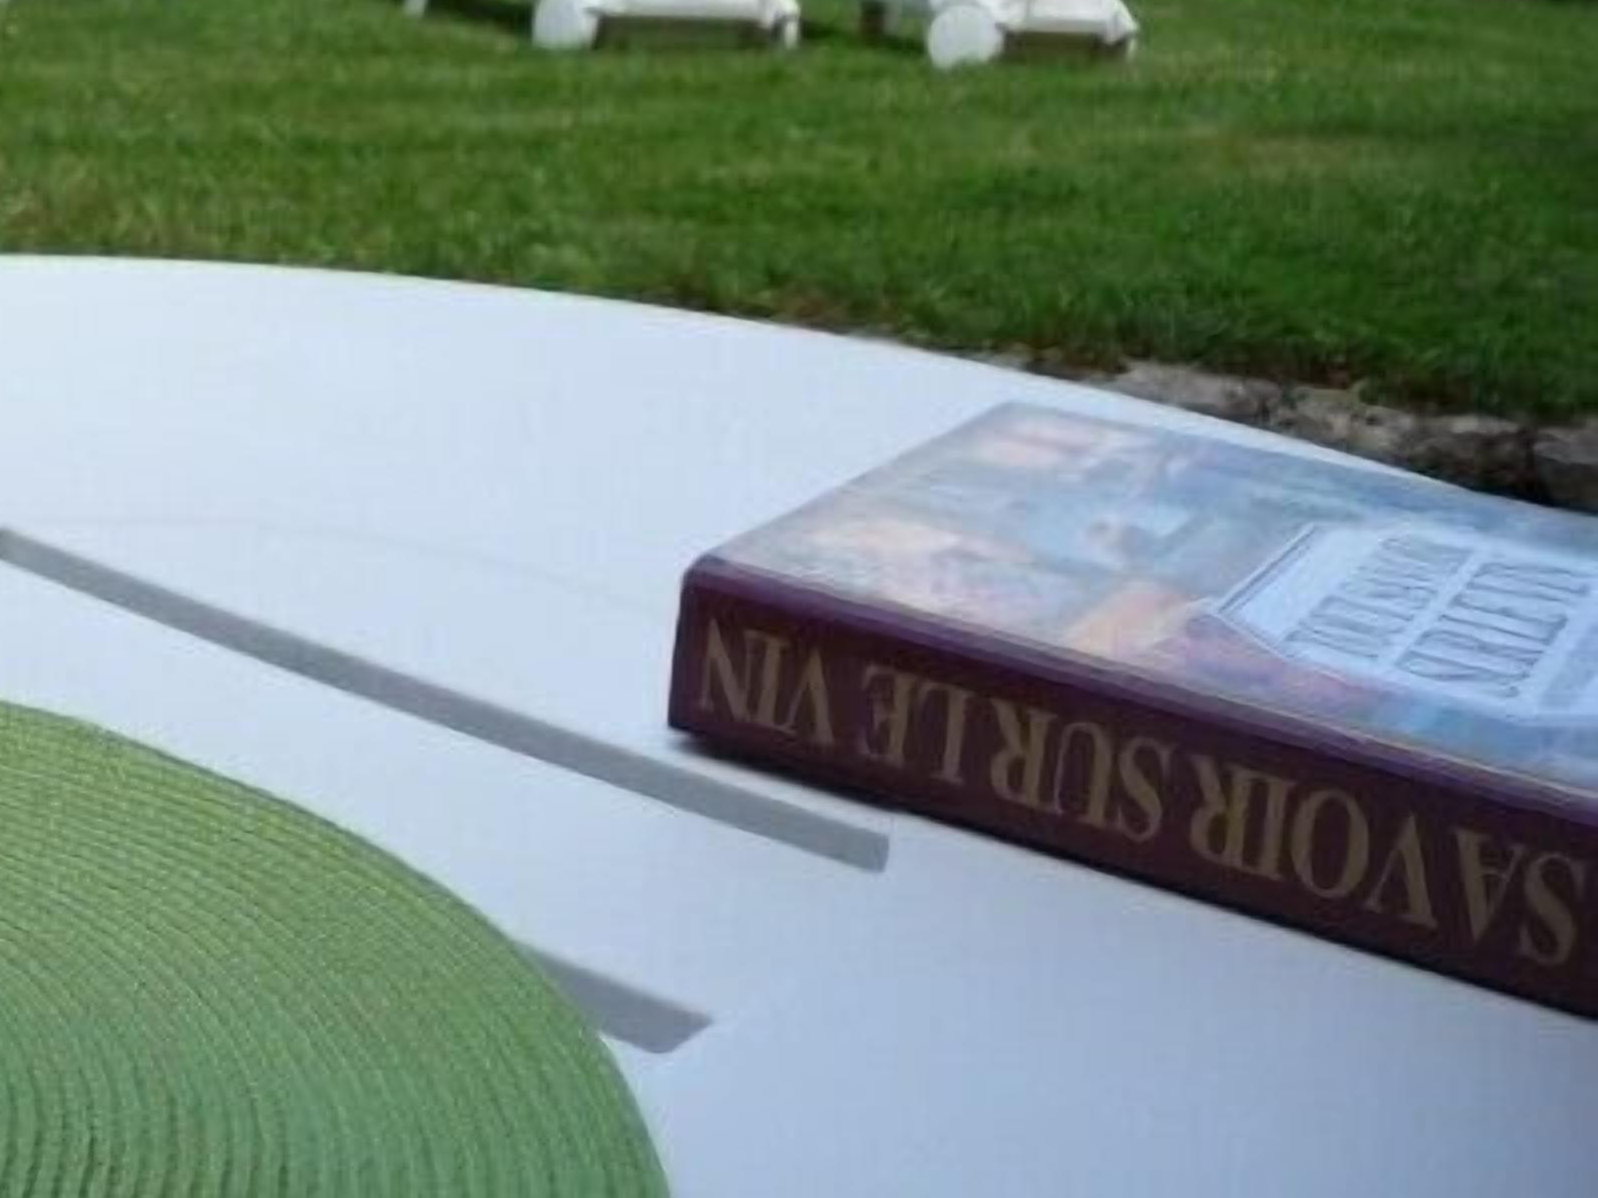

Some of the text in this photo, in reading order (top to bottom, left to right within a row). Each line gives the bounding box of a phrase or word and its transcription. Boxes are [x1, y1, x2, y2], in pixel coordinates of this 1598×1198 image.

[698, 617, 1586, 967] SAVOIR SUR LE VIN
